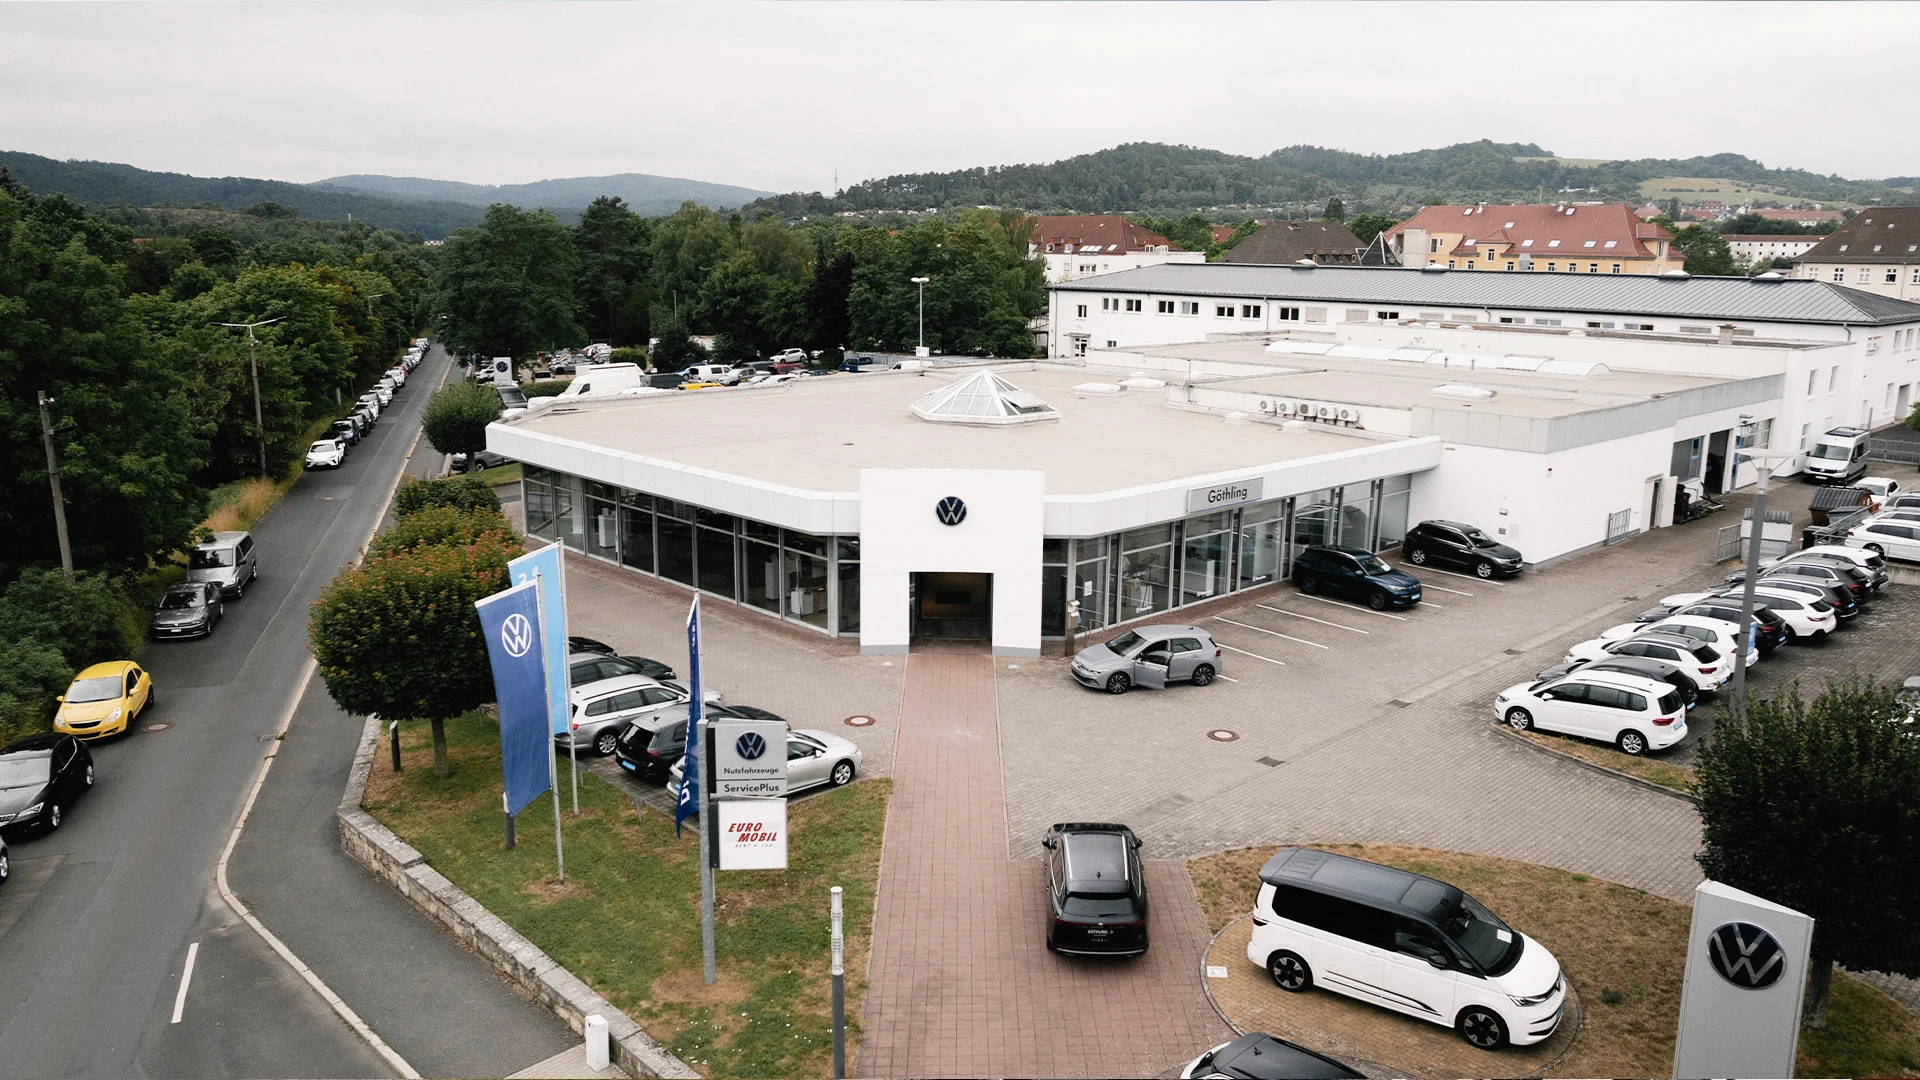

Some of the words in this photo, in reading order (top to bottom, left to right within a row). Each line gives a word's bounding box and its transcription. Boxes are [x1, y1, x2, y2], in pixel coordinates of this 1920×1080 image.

[1208, 485, 1248, 503] Göthling
[937, 496, 967, 525] VW
[502, 614, 531, 656] VW
[736, 732, 766, 760] VW
[723, 766, 779, 775] Nutzfahrzeuge
[724, 783, 780, 793] ServicePlus
[728, 822, 763, 832] EURO
[737, 832, 777, 842] MOBIL
[1709, 921, 1786, 988] VW
